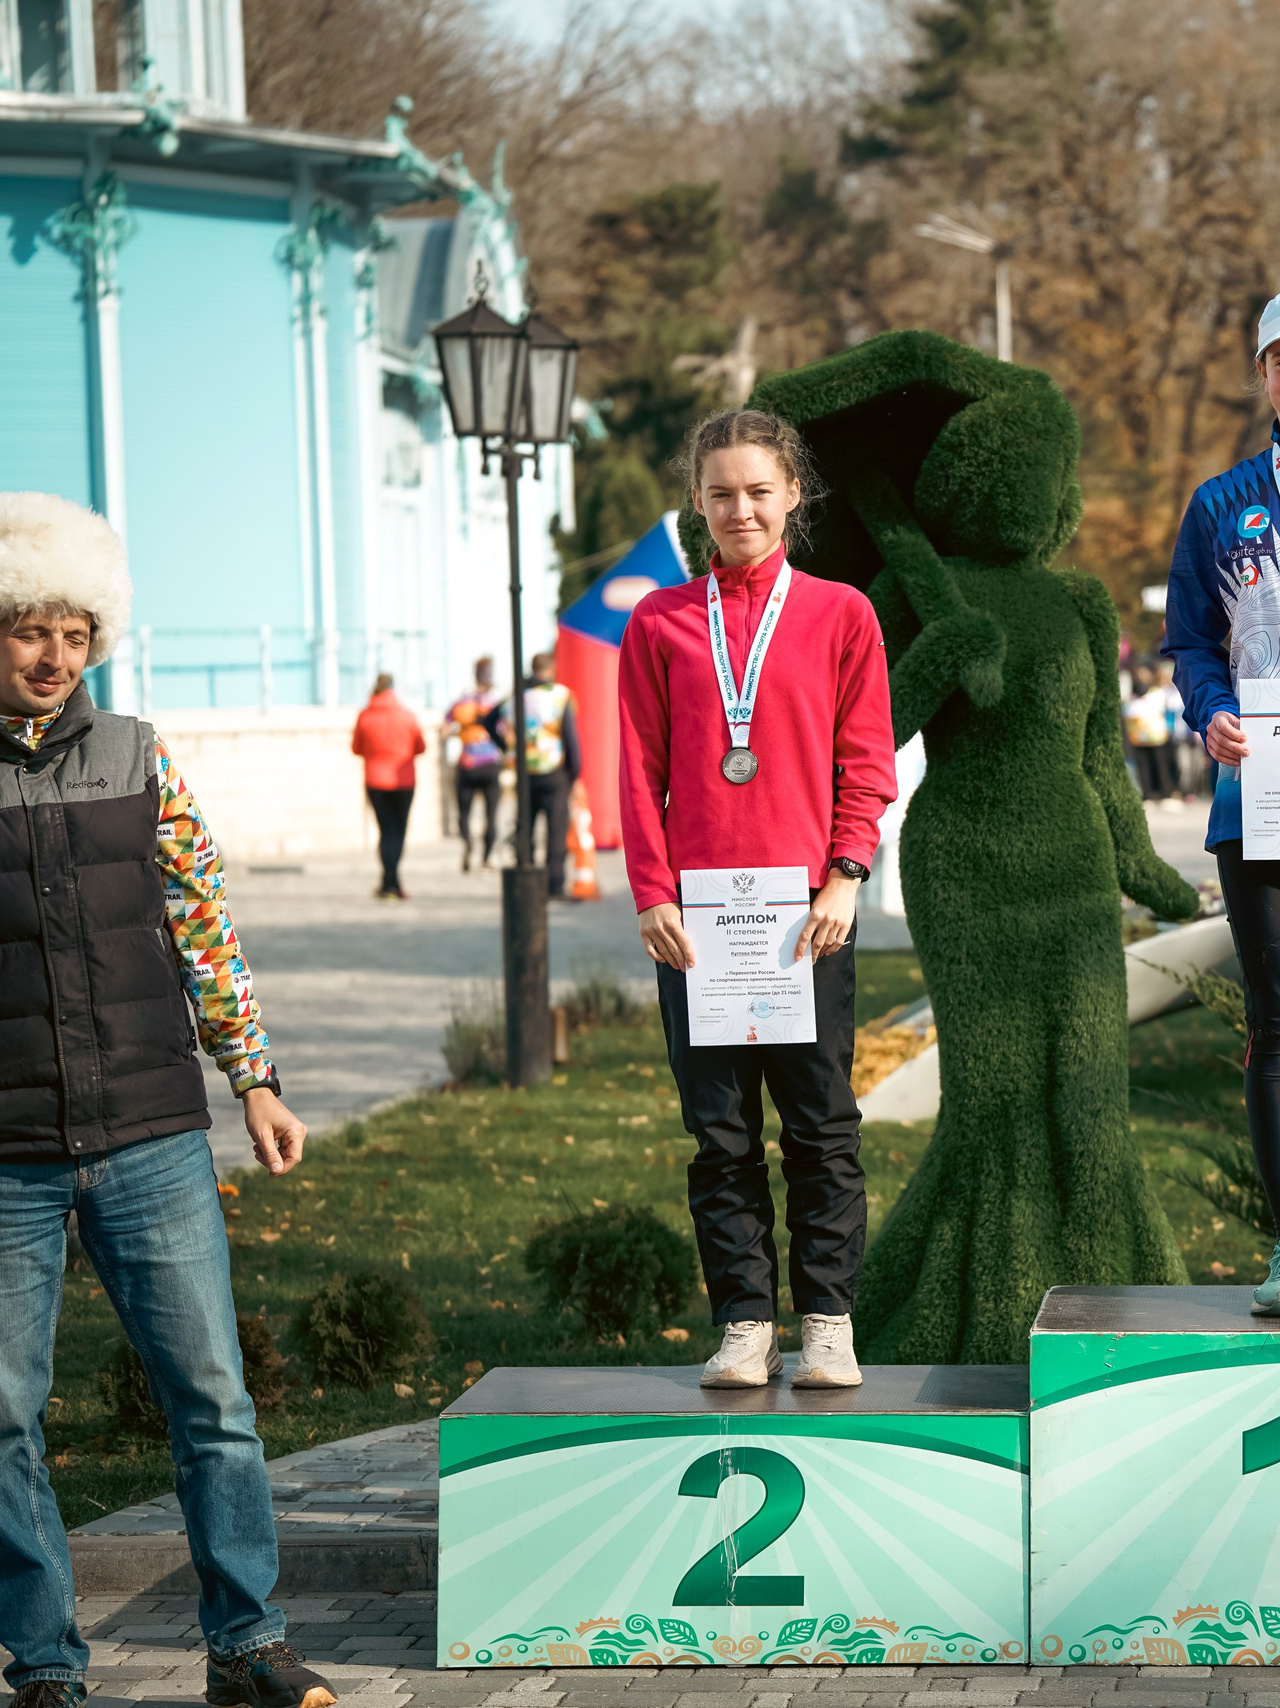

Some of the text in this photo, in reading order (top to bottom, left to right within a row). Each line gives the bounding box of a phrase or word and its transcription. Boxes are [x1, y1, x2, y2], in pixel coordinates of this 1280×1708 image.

[712, 609, 733, 701] МИНИСТЕРСТВО СПОРТА РОССИИ
[745, 610, 775, 701] МИНИСТЕРСТВО СПОРТА РОССИИ
[716, 914, 777, 926] ДИПЛОМ
[672, 1447, 806, 1607] 2
